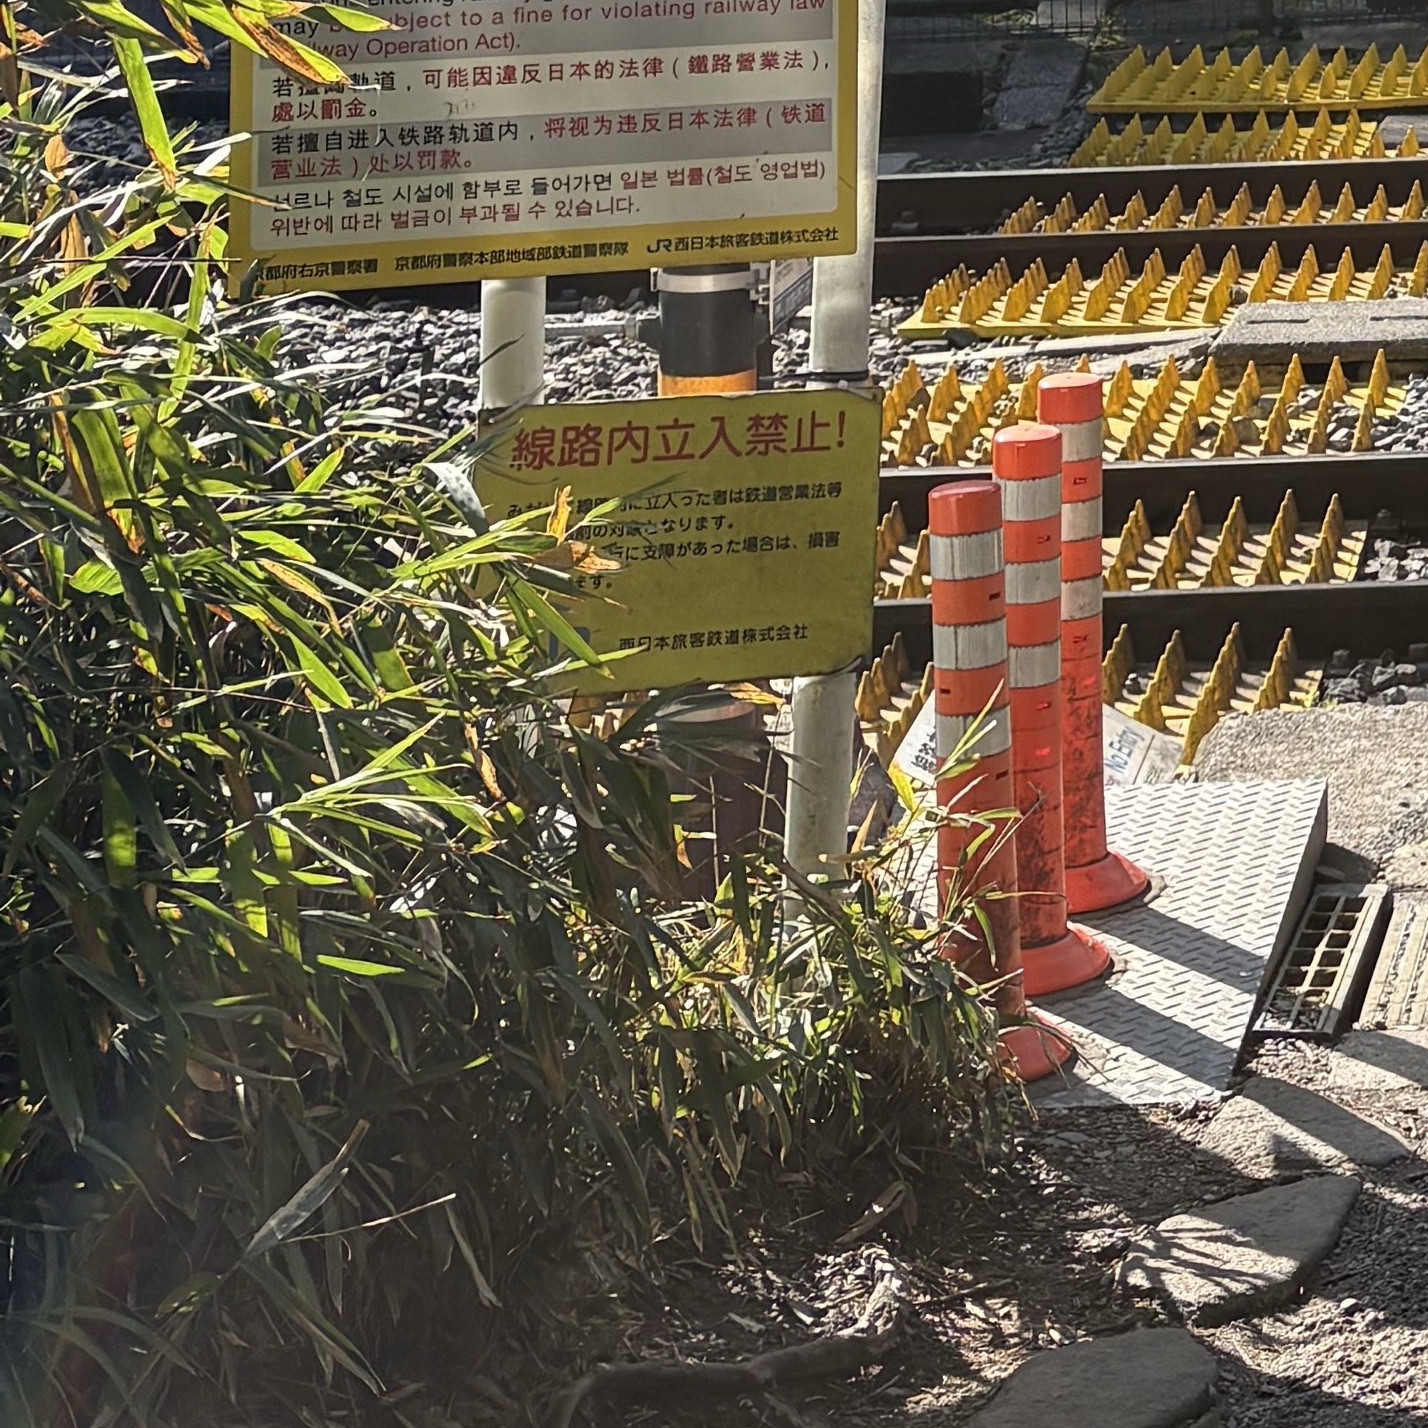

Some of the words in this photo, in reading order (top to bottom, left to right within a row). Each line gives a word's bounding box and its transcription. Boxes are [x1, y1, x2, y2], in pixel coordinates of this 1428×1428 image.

[272, 20, 320, 39] may
[390, 11, 451, 33] bject
[461, 8, 482, 25] to
[492, 12, 504, 24] a
[514, 6, 553, 24] fine
[562, 4, 592, 22] for
[602, 0, 695, 20] violating
[366, 36, 468, 59] Operation
[475, 31, 521, 52] Act).
[342, 188, 384, 208] 철도
[392, 182, 454, 204] 시설에
[462, 178, 523, 200] 함부로
[531, 172, 612, 196] 들어가면
[620, 169, 658, 191] 일본
[270, 215, 333, 237] 위반에
[341, 211, 383, 233] 따라
[528, 201, 547, 220] 수
[555, 195, 641, 219] 있습니다.
